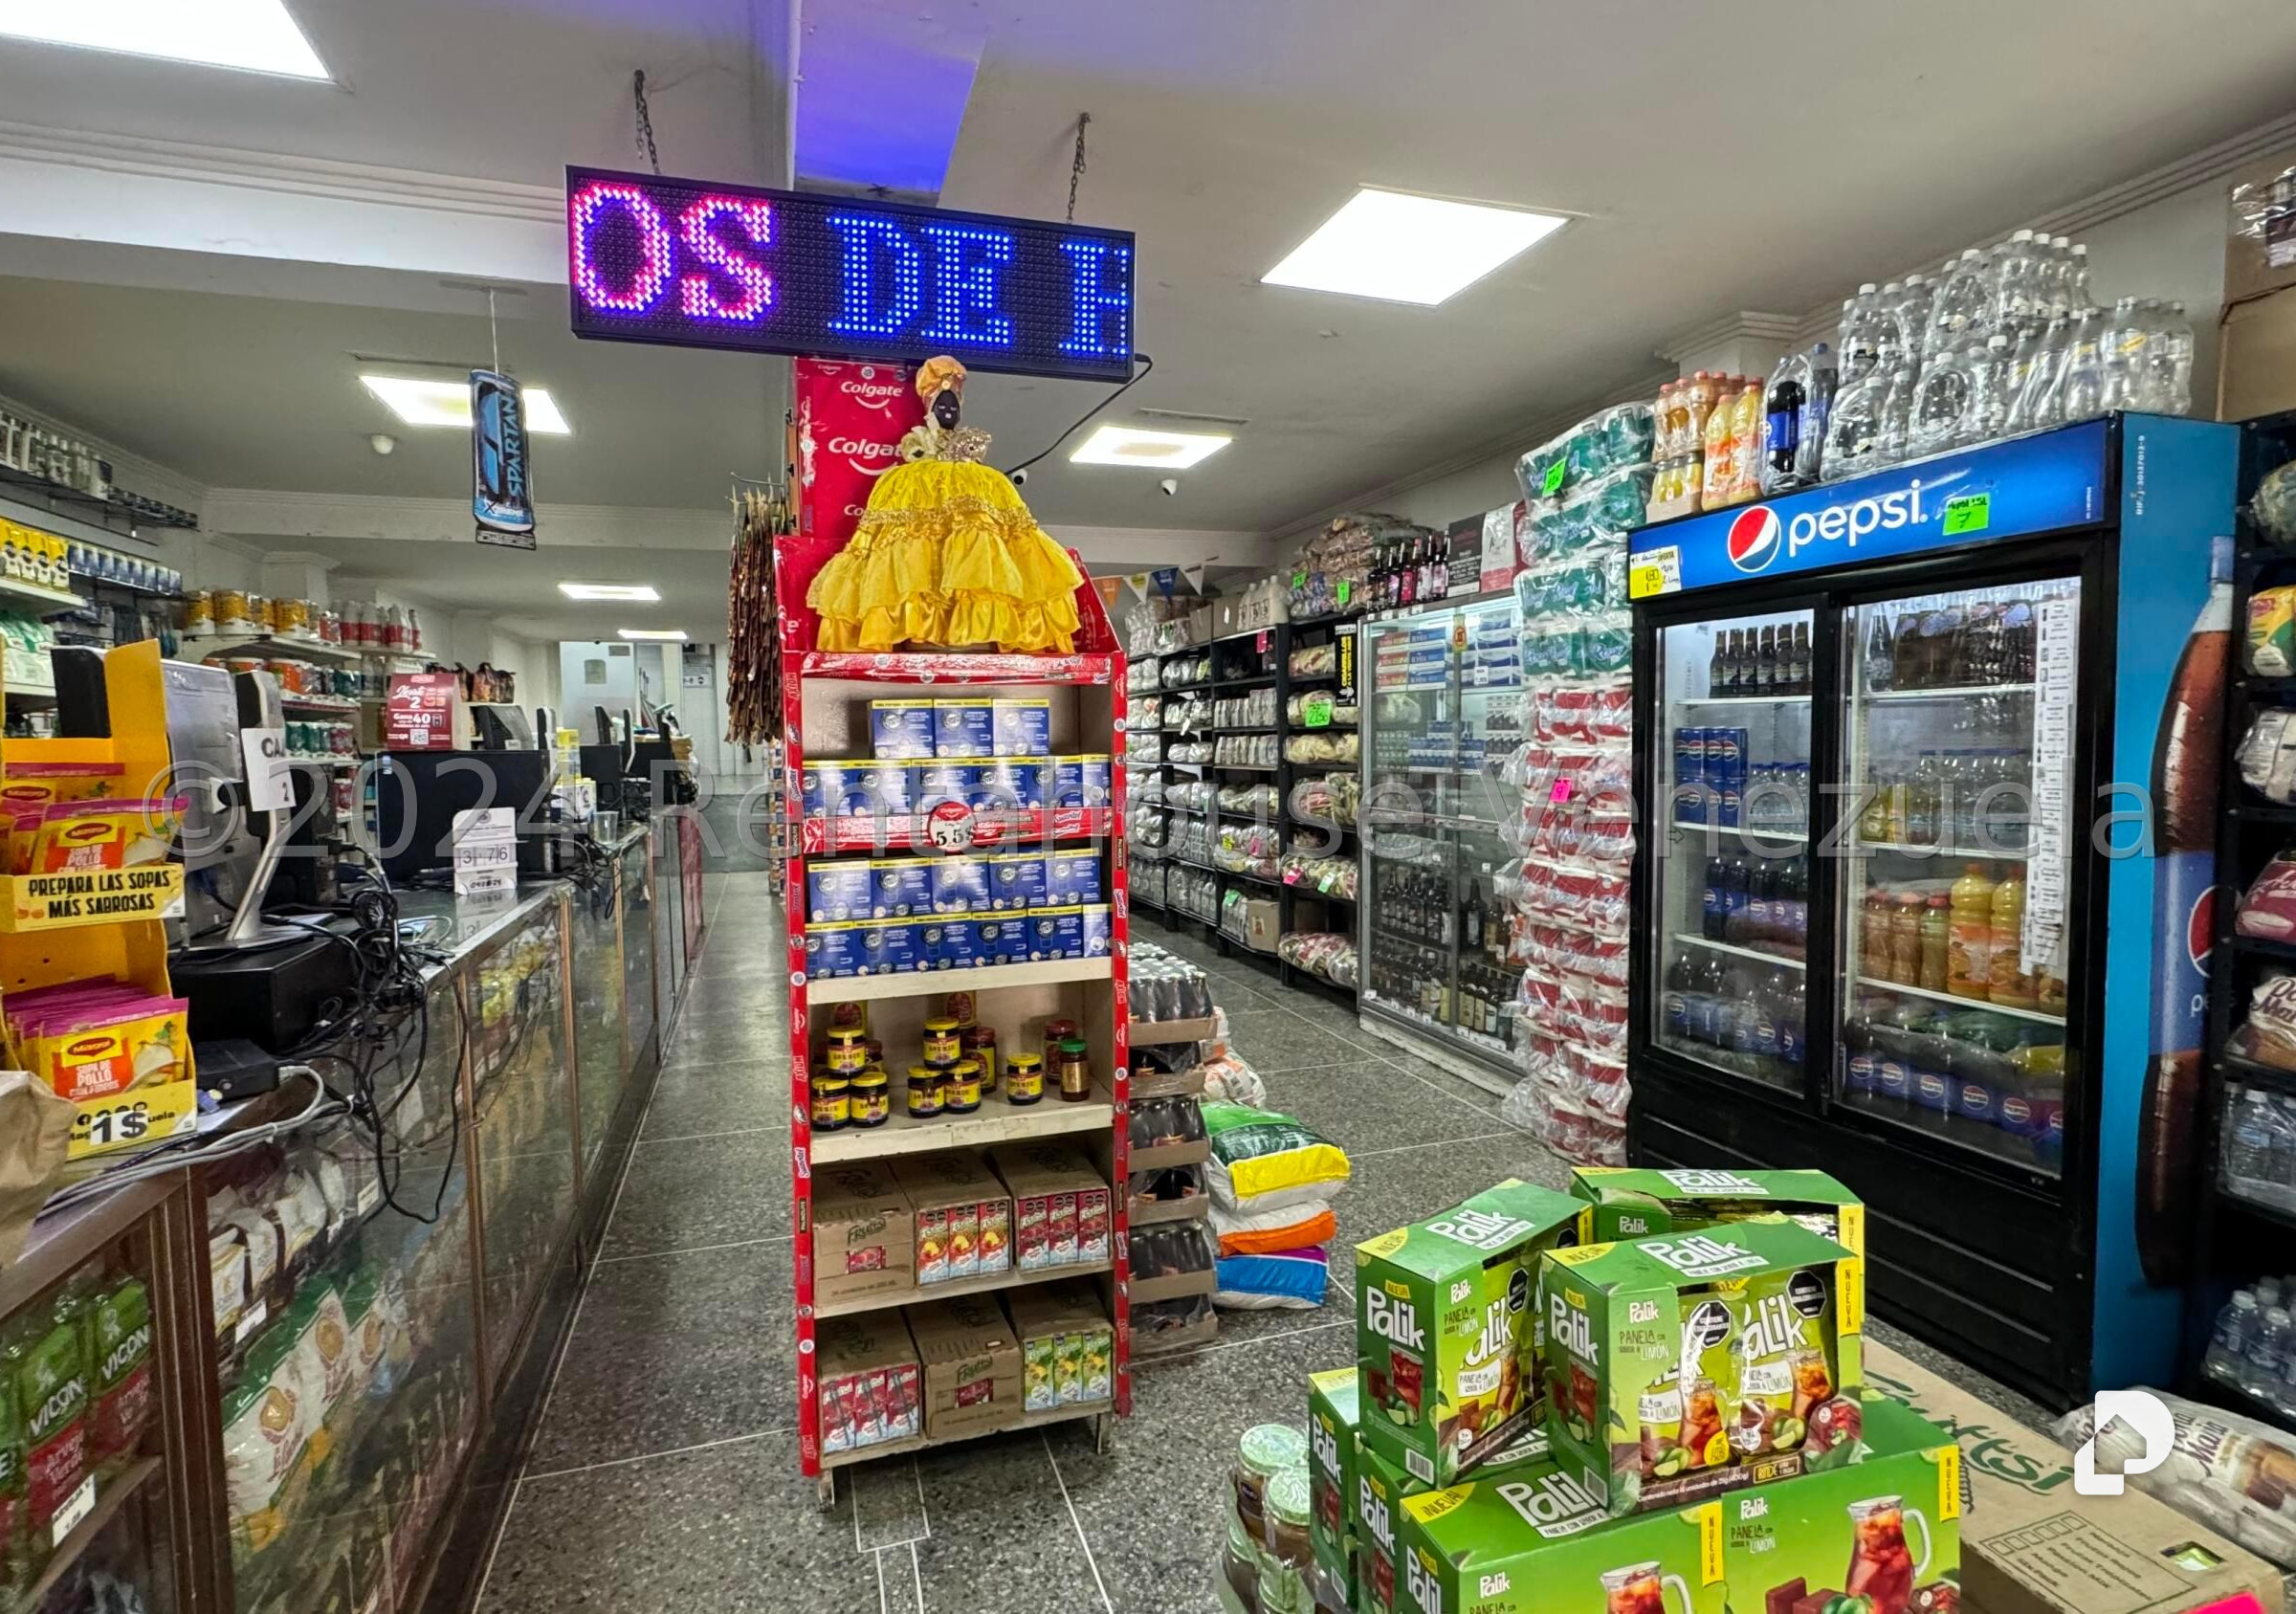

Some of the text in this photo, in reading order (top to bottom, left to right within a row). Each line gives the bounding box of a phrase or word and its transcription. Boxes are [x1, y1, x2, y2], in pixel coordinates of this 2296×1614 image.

[573, 184, 772, 323] OS
[825, 216, 1012, 345] DE
[841, 382, 902, 397] Colgate
[497, 392, 524, 497] SPARTAN
[828, 437, 903, 459] Colgat
[1789, 479, 1920, 557] pepsi
[409, 696, 421, 708] 2
[413, 713, 430, 724] 40
[29, 870, 170, 896] PREPARA LAS SOPAS
[49, 893, 155, 918] MÁS SABROSAS
[73, 1040, 111, 1053] Maggi
[77, 1070, 112, 1087] POLLO
[1657, 1170, 1759, 1188] Palik
[1425, 1209, 1517, 1246] Palik
[1620, 1216, 1648, 1234] Palik
[1637, 1235, 1754, 1270] Palik
[1450, 1278, 1471, 1305] Palik
[1843, 1268, 1854, 1330] NUEVA
[1366, 1286, 1425, 1352] Palik
[1445, 1306, 1470, 1325] PANELA
[1628, 1300, 1659, 1324] Palik
[1551, 1293, 1599, 1366] Palik
[1619, 1329, 1656, 1346] PANELA
[1641, 1343, 1670, 1361] LIMÓN
[30, 1375, 85, 1436] VICON
[1314, 1414, 1342, 1485] Palik
[1496, 1470, 1597, 1526] Pali
[1740, 1496, 1769, 1520] Palik
[1359, 1476, 1396, 1557] Palik
[1544, 1525, 1568, 1537] PANELA
[1568, 1520, 1580, 1530] CON
[1580, 1515, 1597, 1526] SABOR
[1731, 1524, 1764, 1540] PANELA
[1406, 1545, 1442, 1614] Pali
[1479, 1571, 1511, 1600] Palik
[2095, 1563, 2152, 1602] Tropicales
